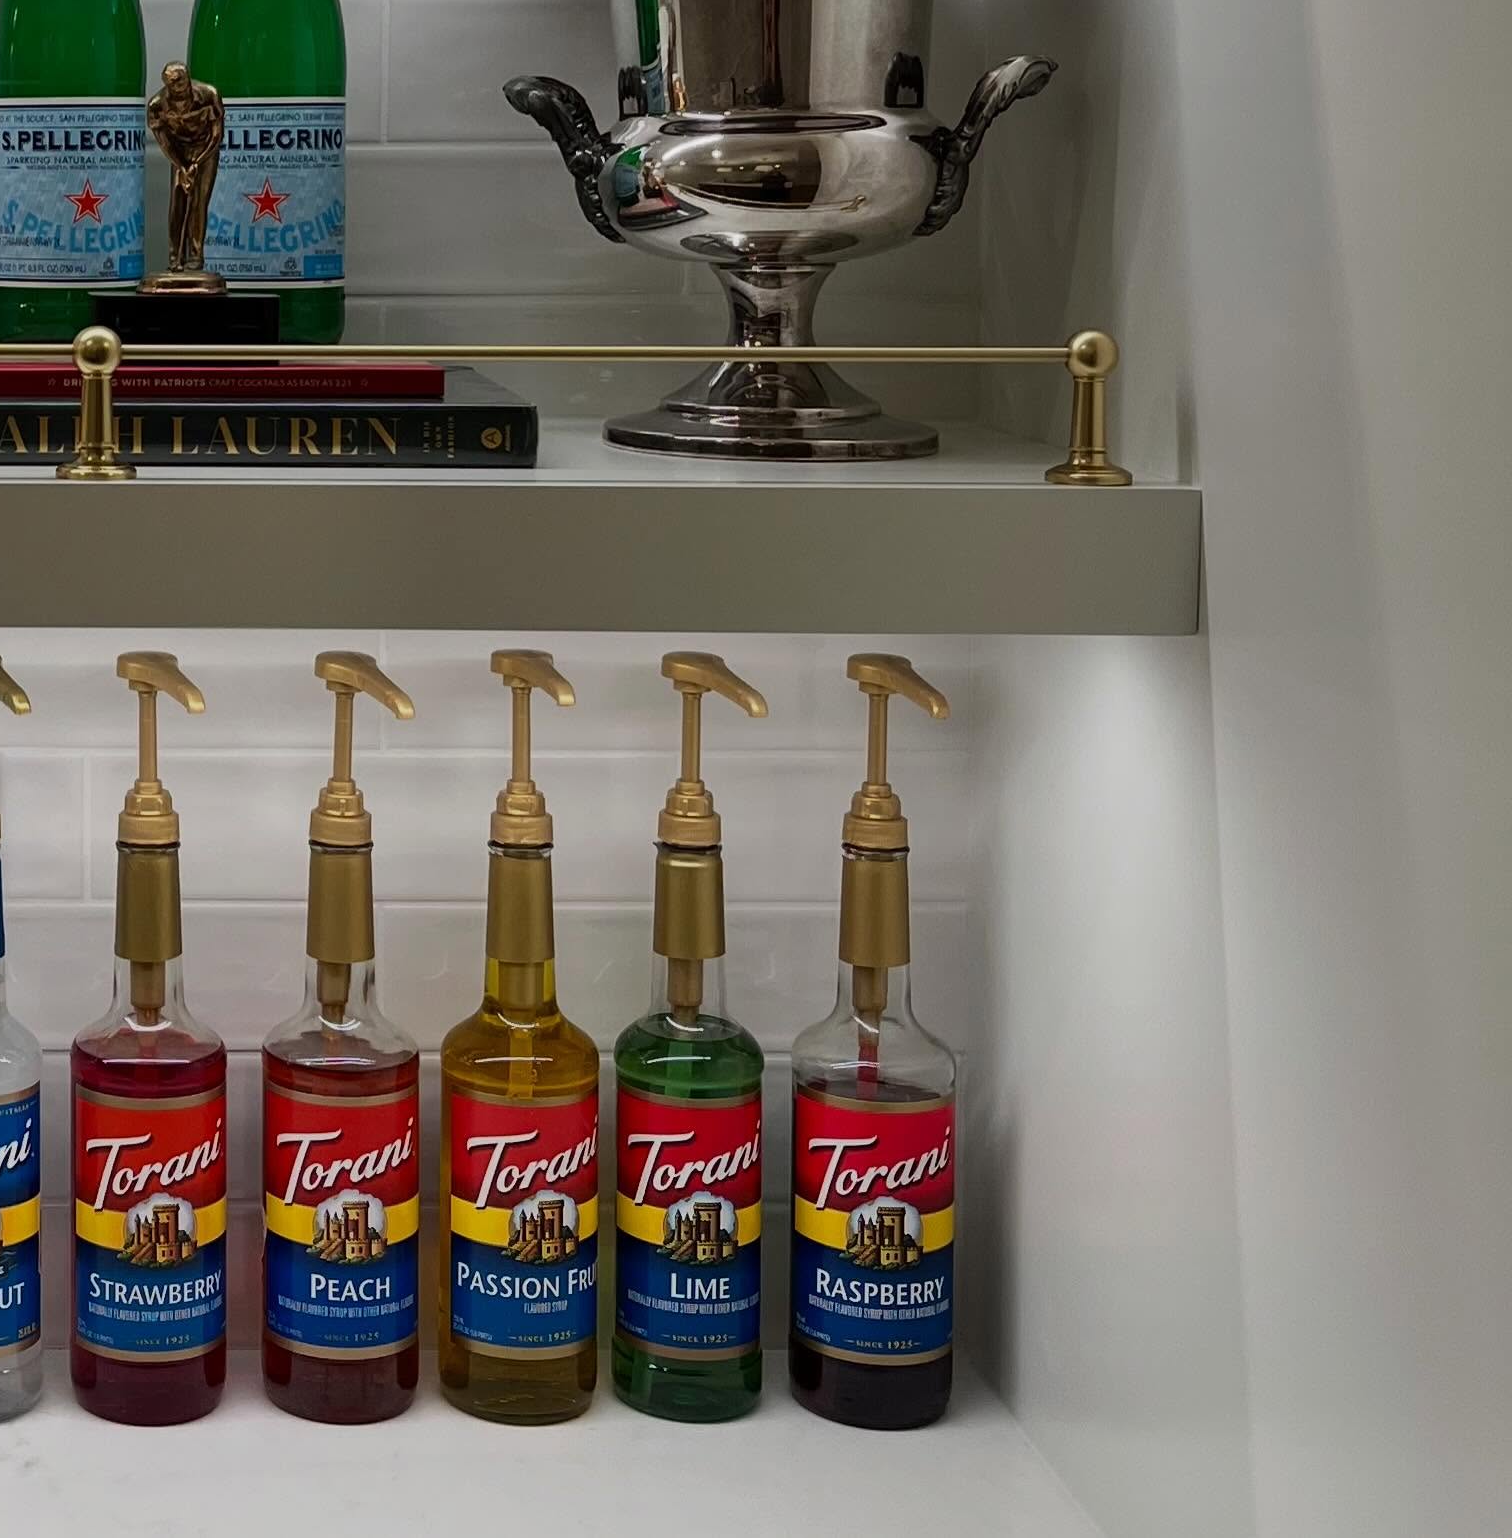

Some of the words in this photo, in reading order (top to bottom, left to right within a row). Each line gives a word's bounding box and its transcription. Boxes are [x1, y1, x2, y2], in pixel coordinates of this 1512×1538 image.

[219, 128, 343, 151] LLEGRINO
[7, 156, 51, 165] SPARKLING
[54, 156, 96, 164] NATURAL
[233, 154, 277, 163] NATURAL
[63, 379, 119, 387] DRIG
[122, 378, 151, 387] WITH
[154, 378, 206, 387] PATRIOTS
[209, 378, 235, 387] CRAFT
[237, 378, 285, 387] COCKTAILS
[299, 378, 320, 387] EASY
[171, 416, 400, 455] LAUREN
[86, 1118, 222, 1211] Torani
[277, 1117, 413, 1204] Torani
[467, 1115, 597, 1209] Torani
[628, 1120, 760, 1205] Torani
[808, 1126, 951, 1209] Torani
[90, 1270, 222, 1306] STRAWBERRY
[311, 1273, 390, 1302] PEACH
[458, 1262, 560, 1299] PASSION
[670, 1273, 730, 1299] LIME
[816, 1267, 945, 1306] RASPBERRY
[166, 1335, 190, 1345] 1925
[354, 1332, 379, 1342] 1925
[548, 1331, 571, 1342] 1925
[703, 1333, 729, 1343] 1925
[887, 1339, 913, 1350] 1925
